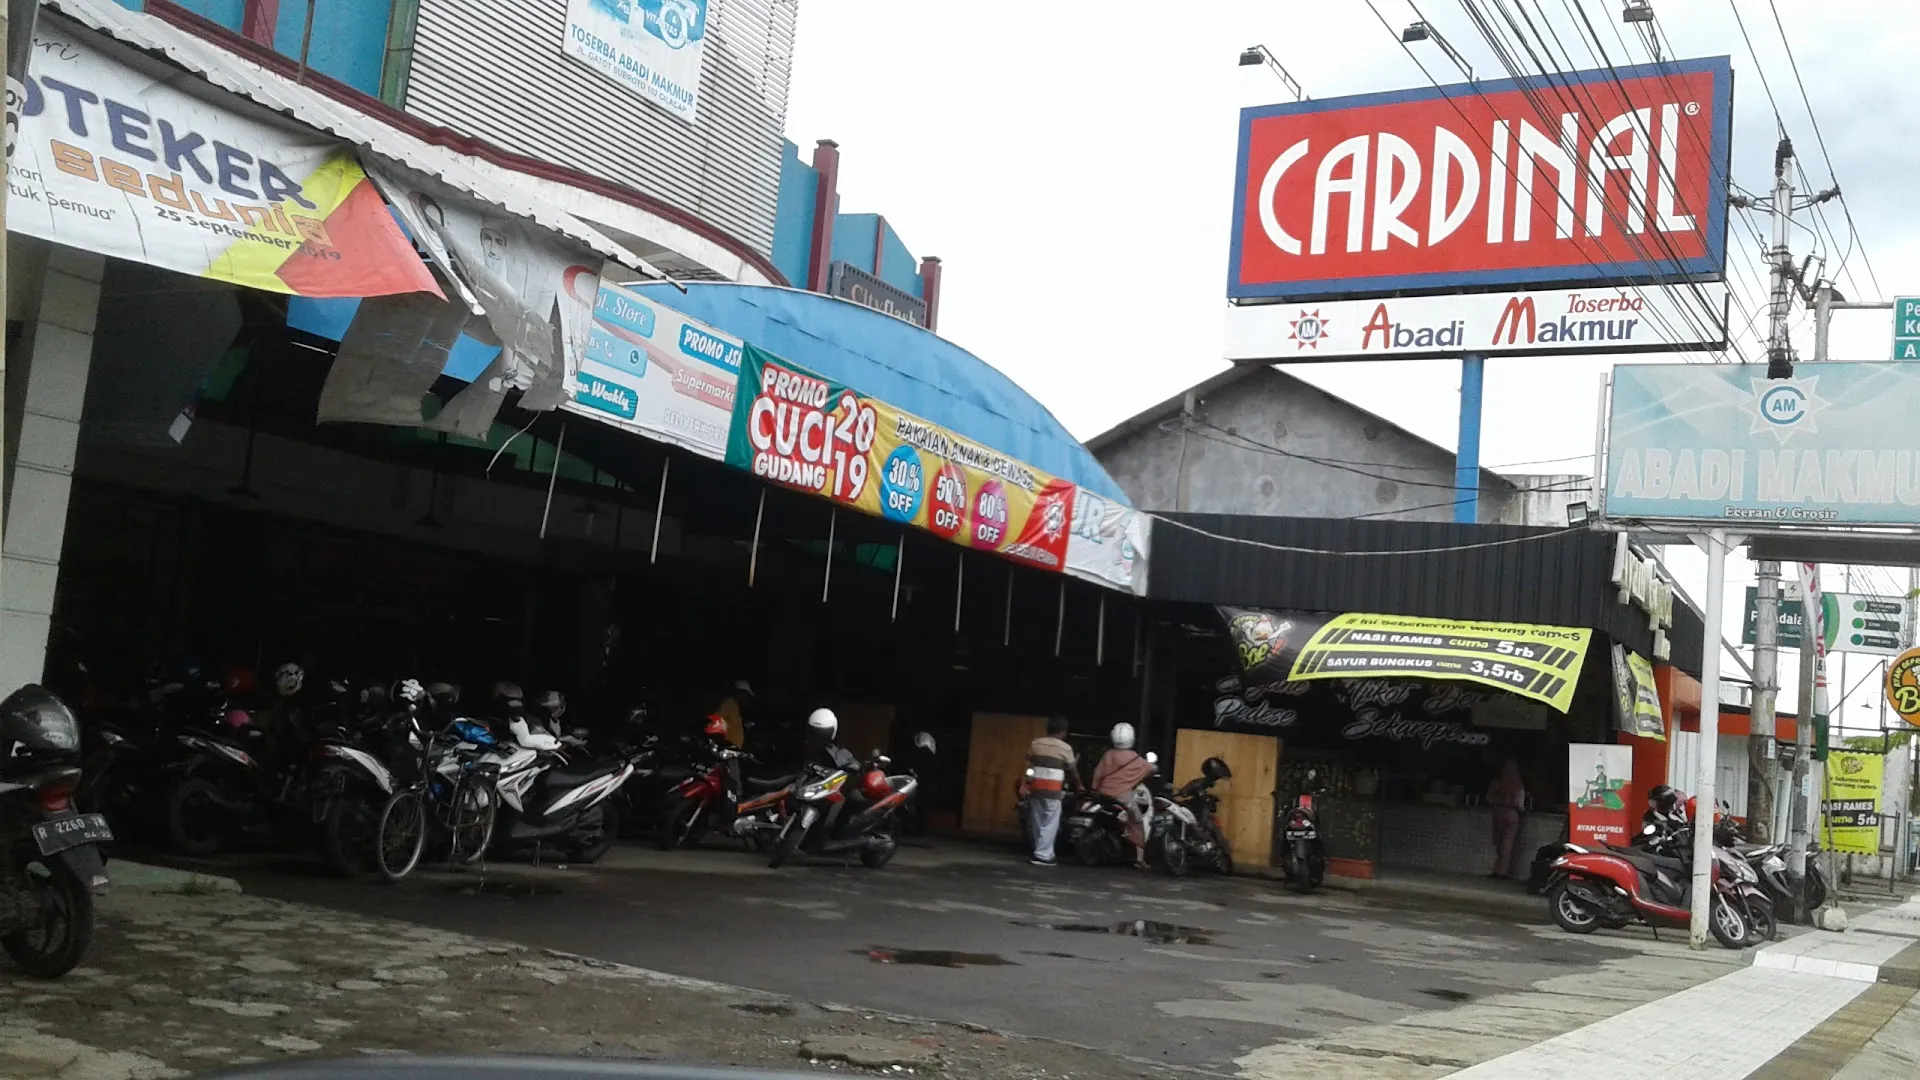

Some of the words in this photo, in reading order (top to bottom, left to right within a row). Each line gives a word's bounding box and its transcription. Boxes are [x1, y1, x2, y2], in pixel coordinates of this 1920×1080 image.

[571, 23, 616, 62] TOSERBA
[618, 53, 650, 81] ABADI
[651, 71, 694, 107] MAKMUR
[154, 205, 183, 223] 25
[185, 214, 294, 251] September
[613, 295, 648, 326] Store
[1566, 291, 1644, 314] Toserba
[1361, 302, 1465, 351] Abadi
[1491, 295, 1639, 346] Makmur
[683, 328, 725, 361] PROMO
[762, 366, 829, 410] PROMO
[749, 395, 836, 466] CUCI
[834, 395, 877, 452] 20
[754, 452, 826, 490] GUDANG
[833, 450, 868, 500] 19
[1613, 448, 1745, 502] ABADI
[888, 490, 914, 514] OFF
[1724, 505, 1773, 519] Eceran
[1775, 506, 1789, 519] &
[1791, 506, 1839, 520] Grosir
[935, 508, 960, 530] OFF
[977, 523, 1000, 544] OFF
[1350, 631, 1387, 643] NASI
[1389, 635, 1443, 646] RAMES
[1448, 638, 1489, 649] cuma
[1470, 625, 1526, 636] warung
[1327, 656, 1367, 668] SAYUR
[1369, 656, 1434, 668] BUNGKUS
[1469, 660, 1526, 683] 3,5rb
[1843, 801, 1874, 811] RAMES
[55, 818, 86, 834] 2260
